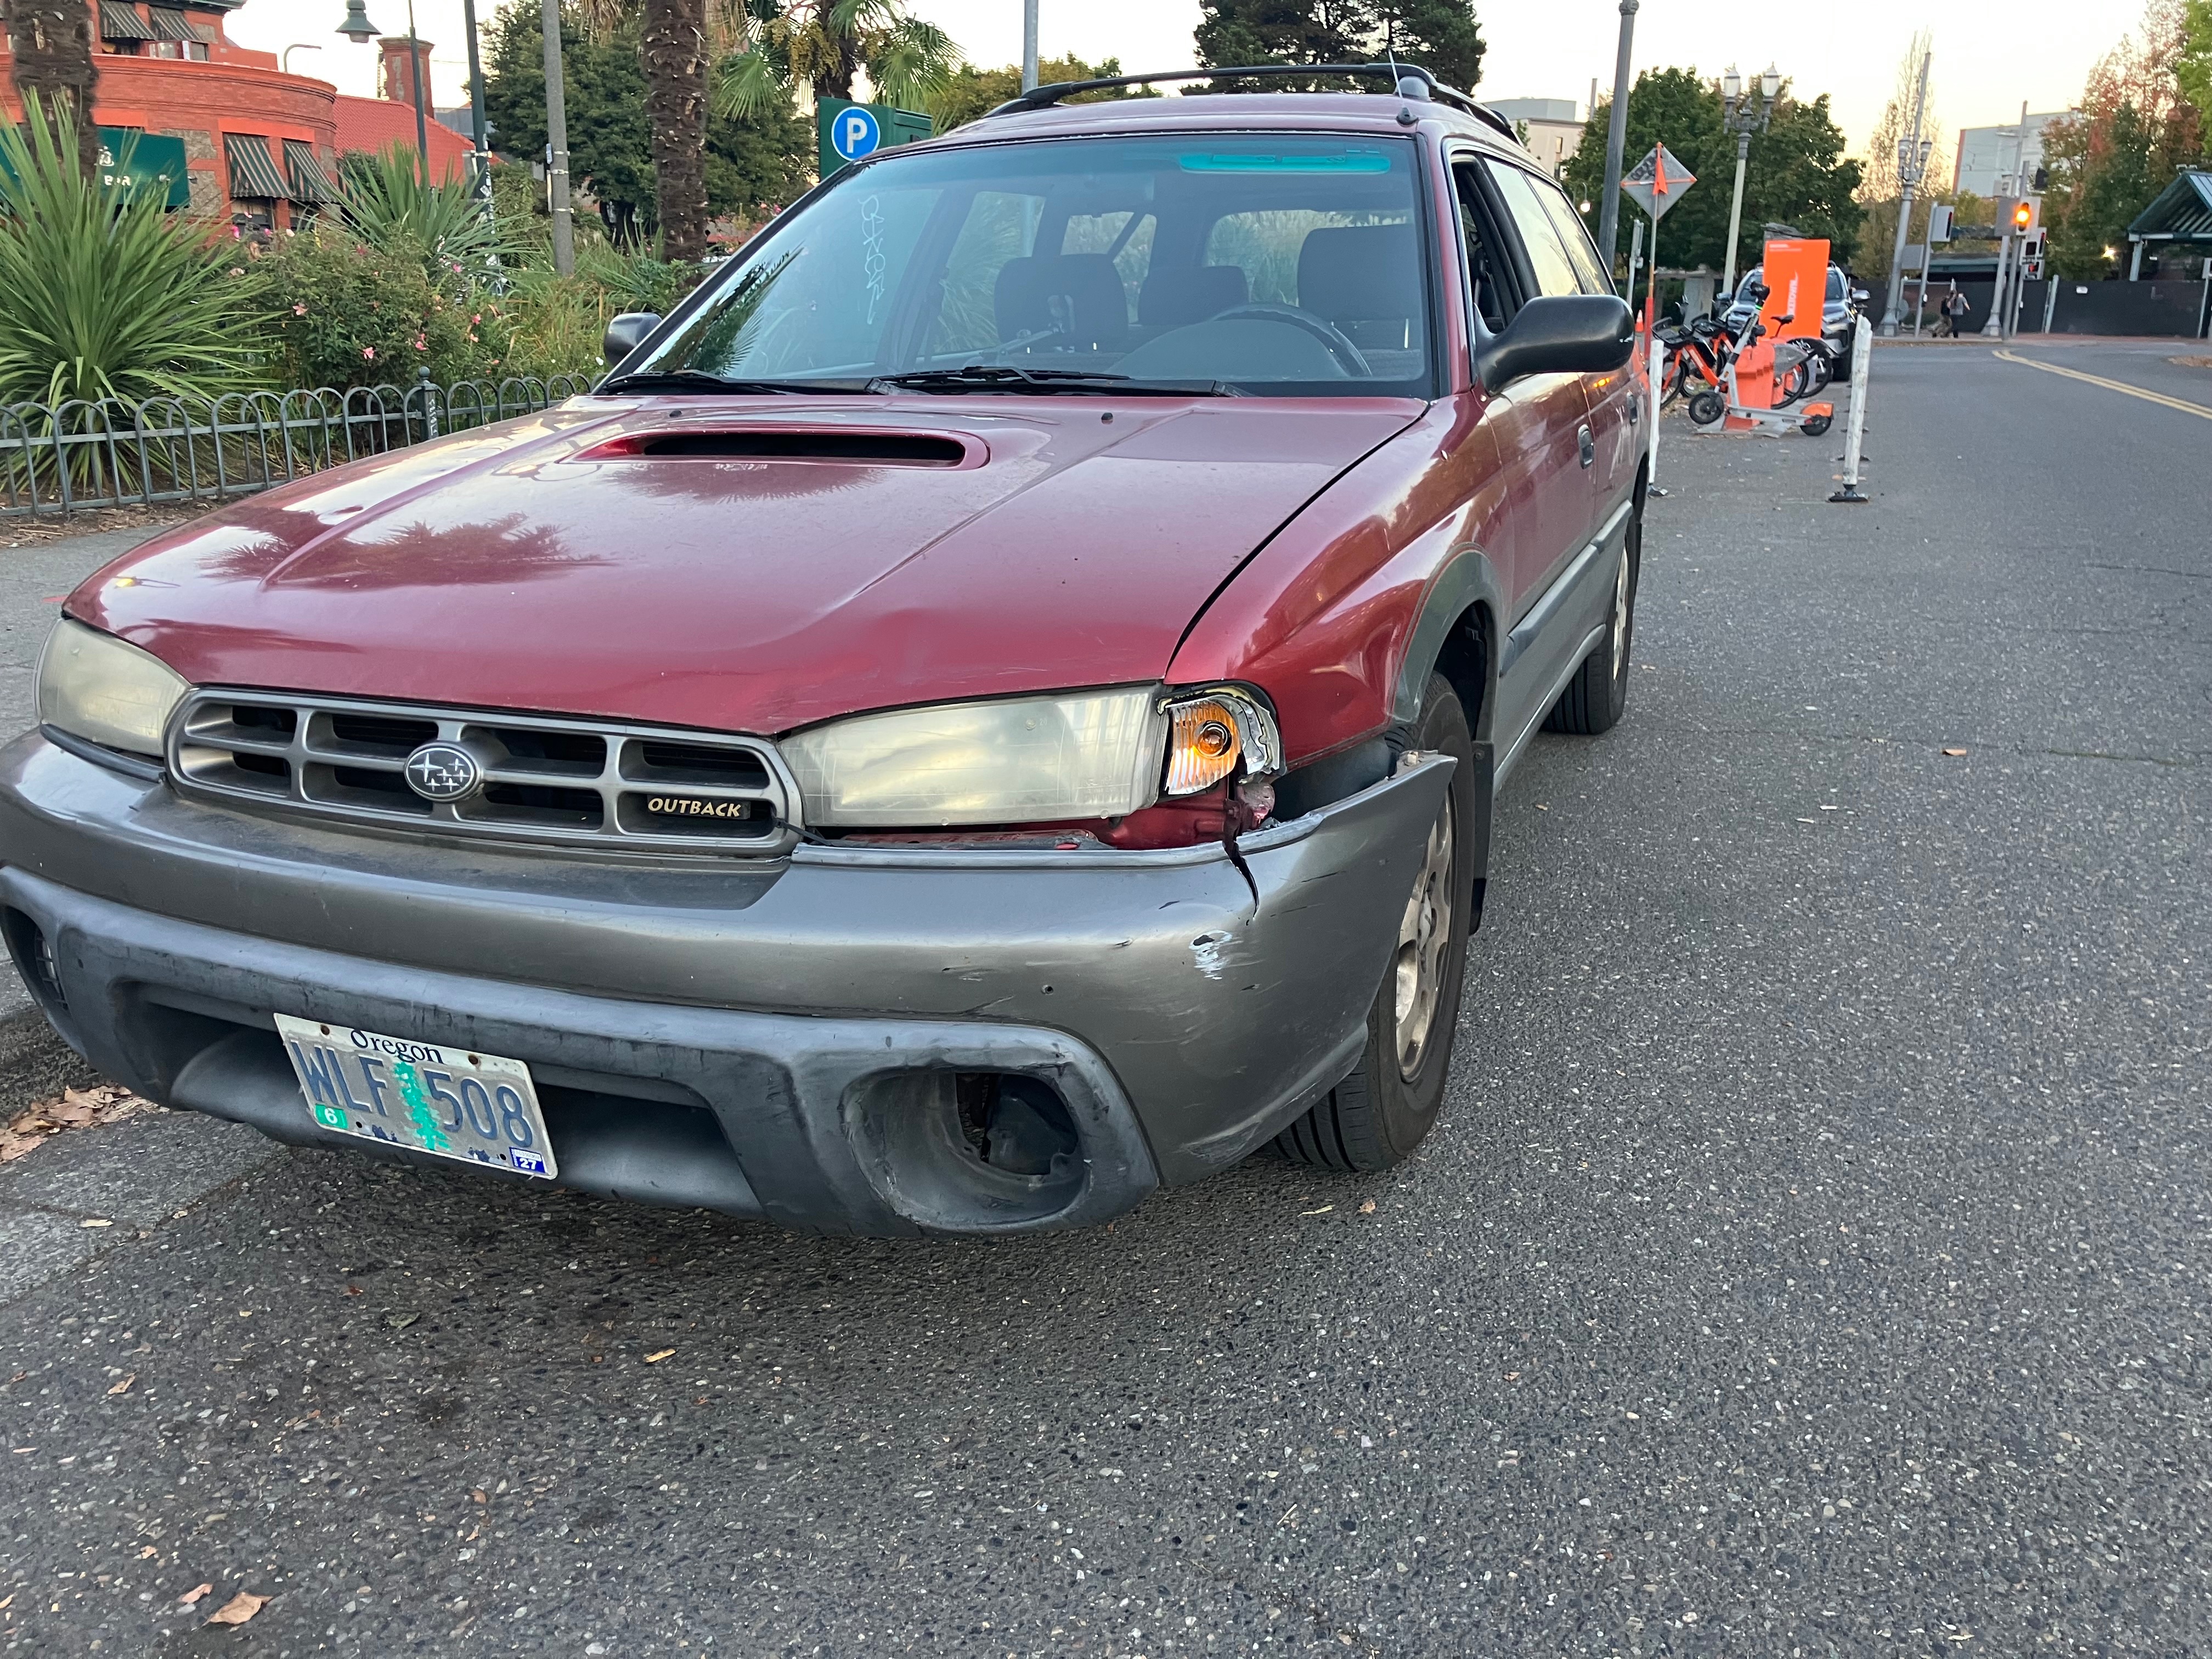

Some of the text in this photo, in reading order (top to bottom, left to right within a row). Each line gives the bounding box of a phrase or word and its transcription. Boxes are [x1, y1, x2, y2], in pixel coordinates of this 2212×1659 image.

[847, 117, 867, 154] P
[648, 798, 741, 817] OUTBACK
[351, 1029, 448, 1065] Oregon
[290, 1039, 534, 1148] WLF 508
[324, 1107, 338, 1124] 6
[519, 1158, 537, 1170] 27
